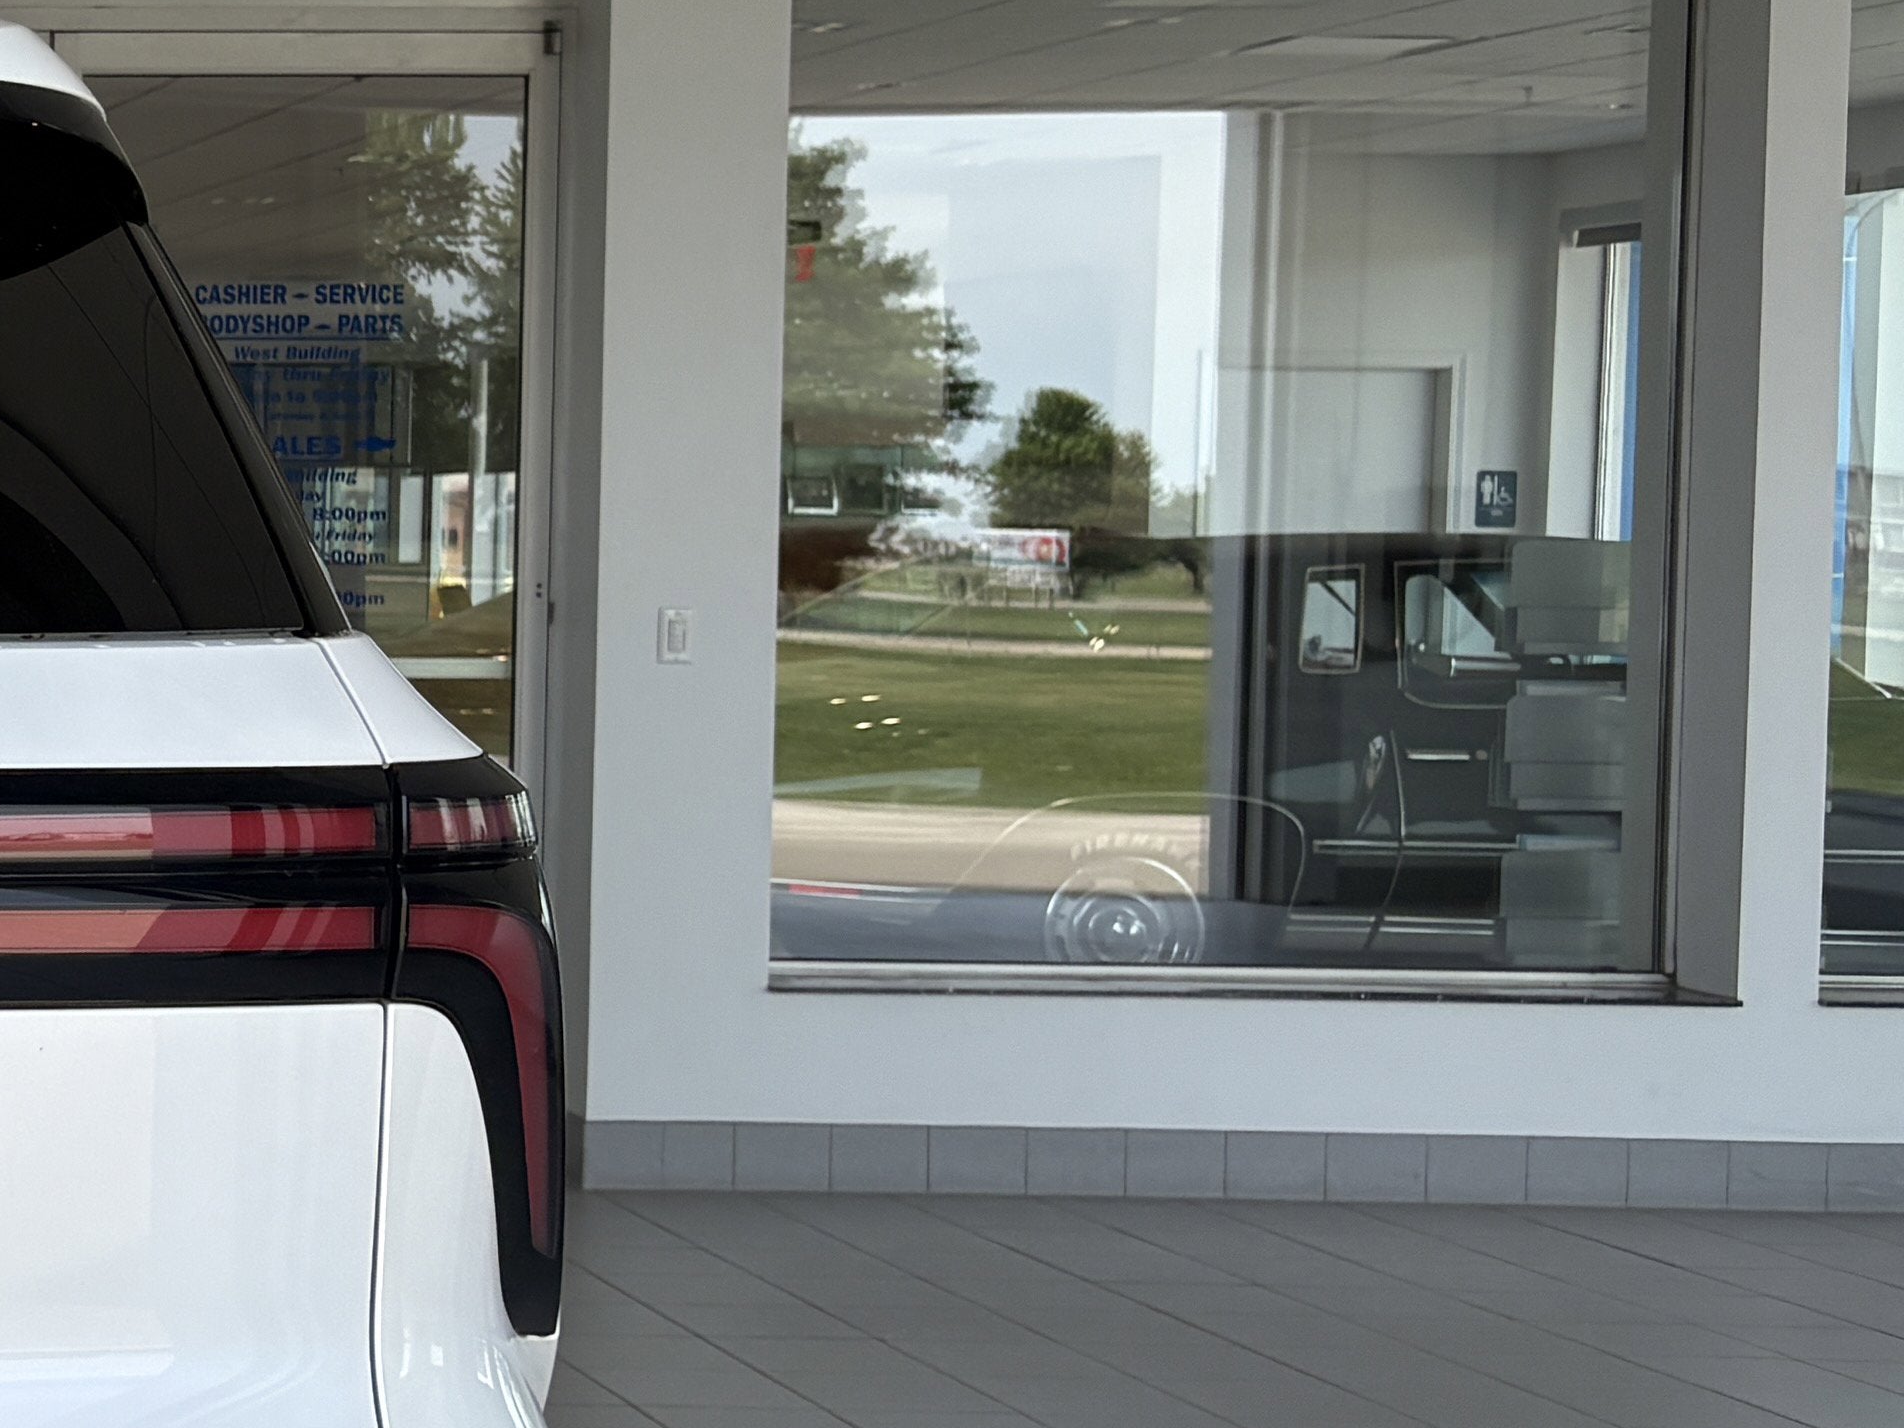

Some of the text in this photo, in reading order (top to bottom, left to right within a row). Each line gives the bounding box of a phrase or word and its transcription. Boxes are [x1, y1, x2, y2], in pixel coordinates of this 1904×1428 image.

[195, 284, 287, 305] CASHIER
[314, 284, 405, 305] SERVICE
[338, 314, 404, 334] PARTS
[234, 345, 361, 363] West Building
[272, 435, 342, 456] ALES
[324, 550, 386, 565] :00pm
